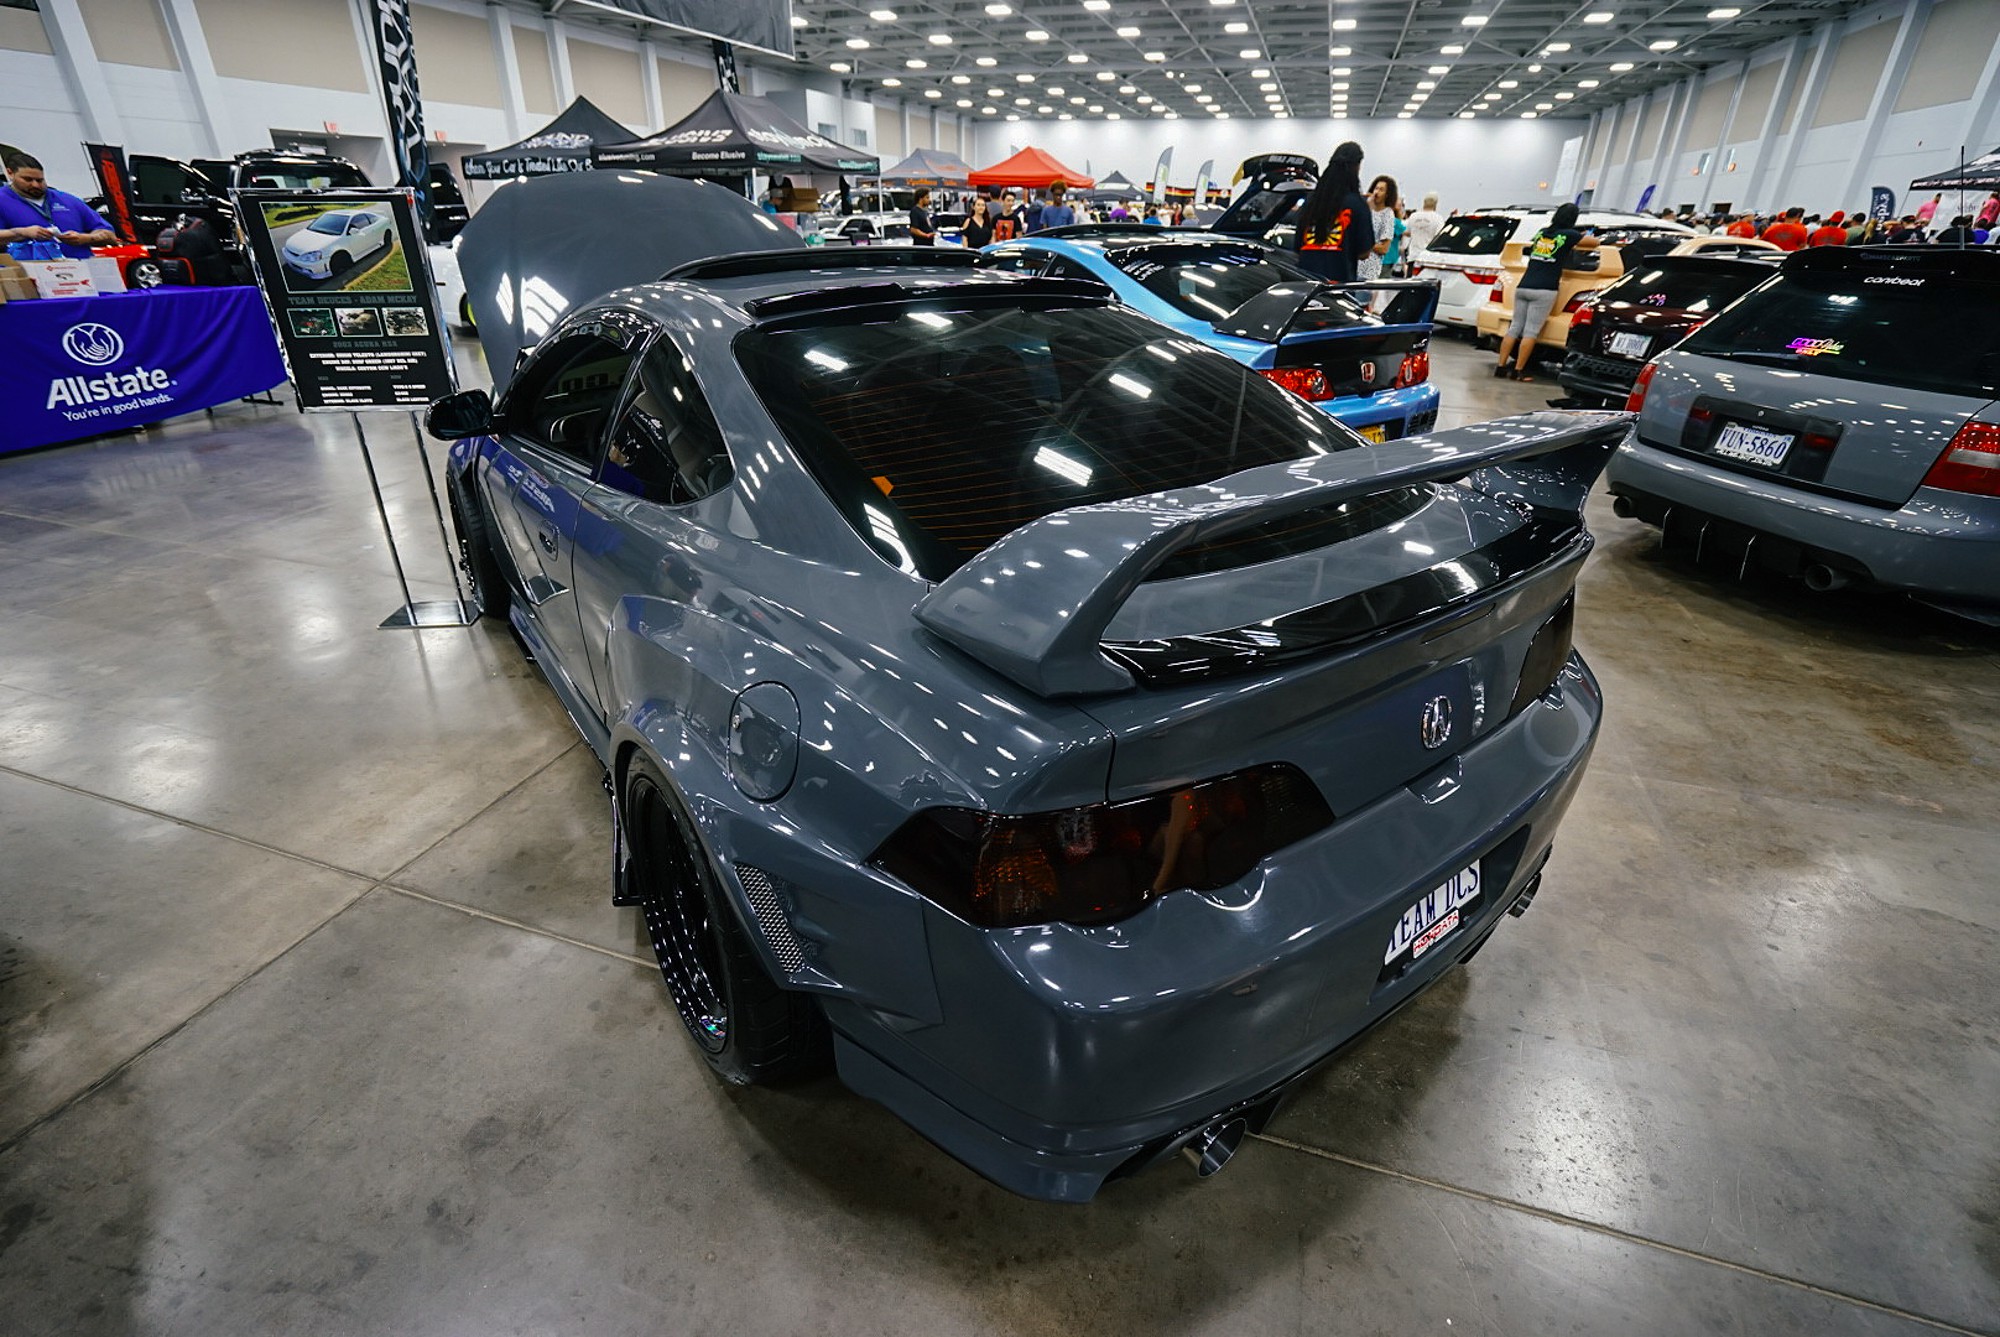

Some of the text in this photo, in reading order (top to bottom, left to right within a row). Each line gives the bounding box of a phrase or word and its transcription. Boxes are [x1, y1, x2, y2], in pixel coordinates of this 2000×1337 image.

[692, 151, 719, 161] Become
[720, 150, 746, 160] Elusive
[62, 393, 175, 421] You're in good hands.
[1720, 429, 1787, 459] VUN-5860
